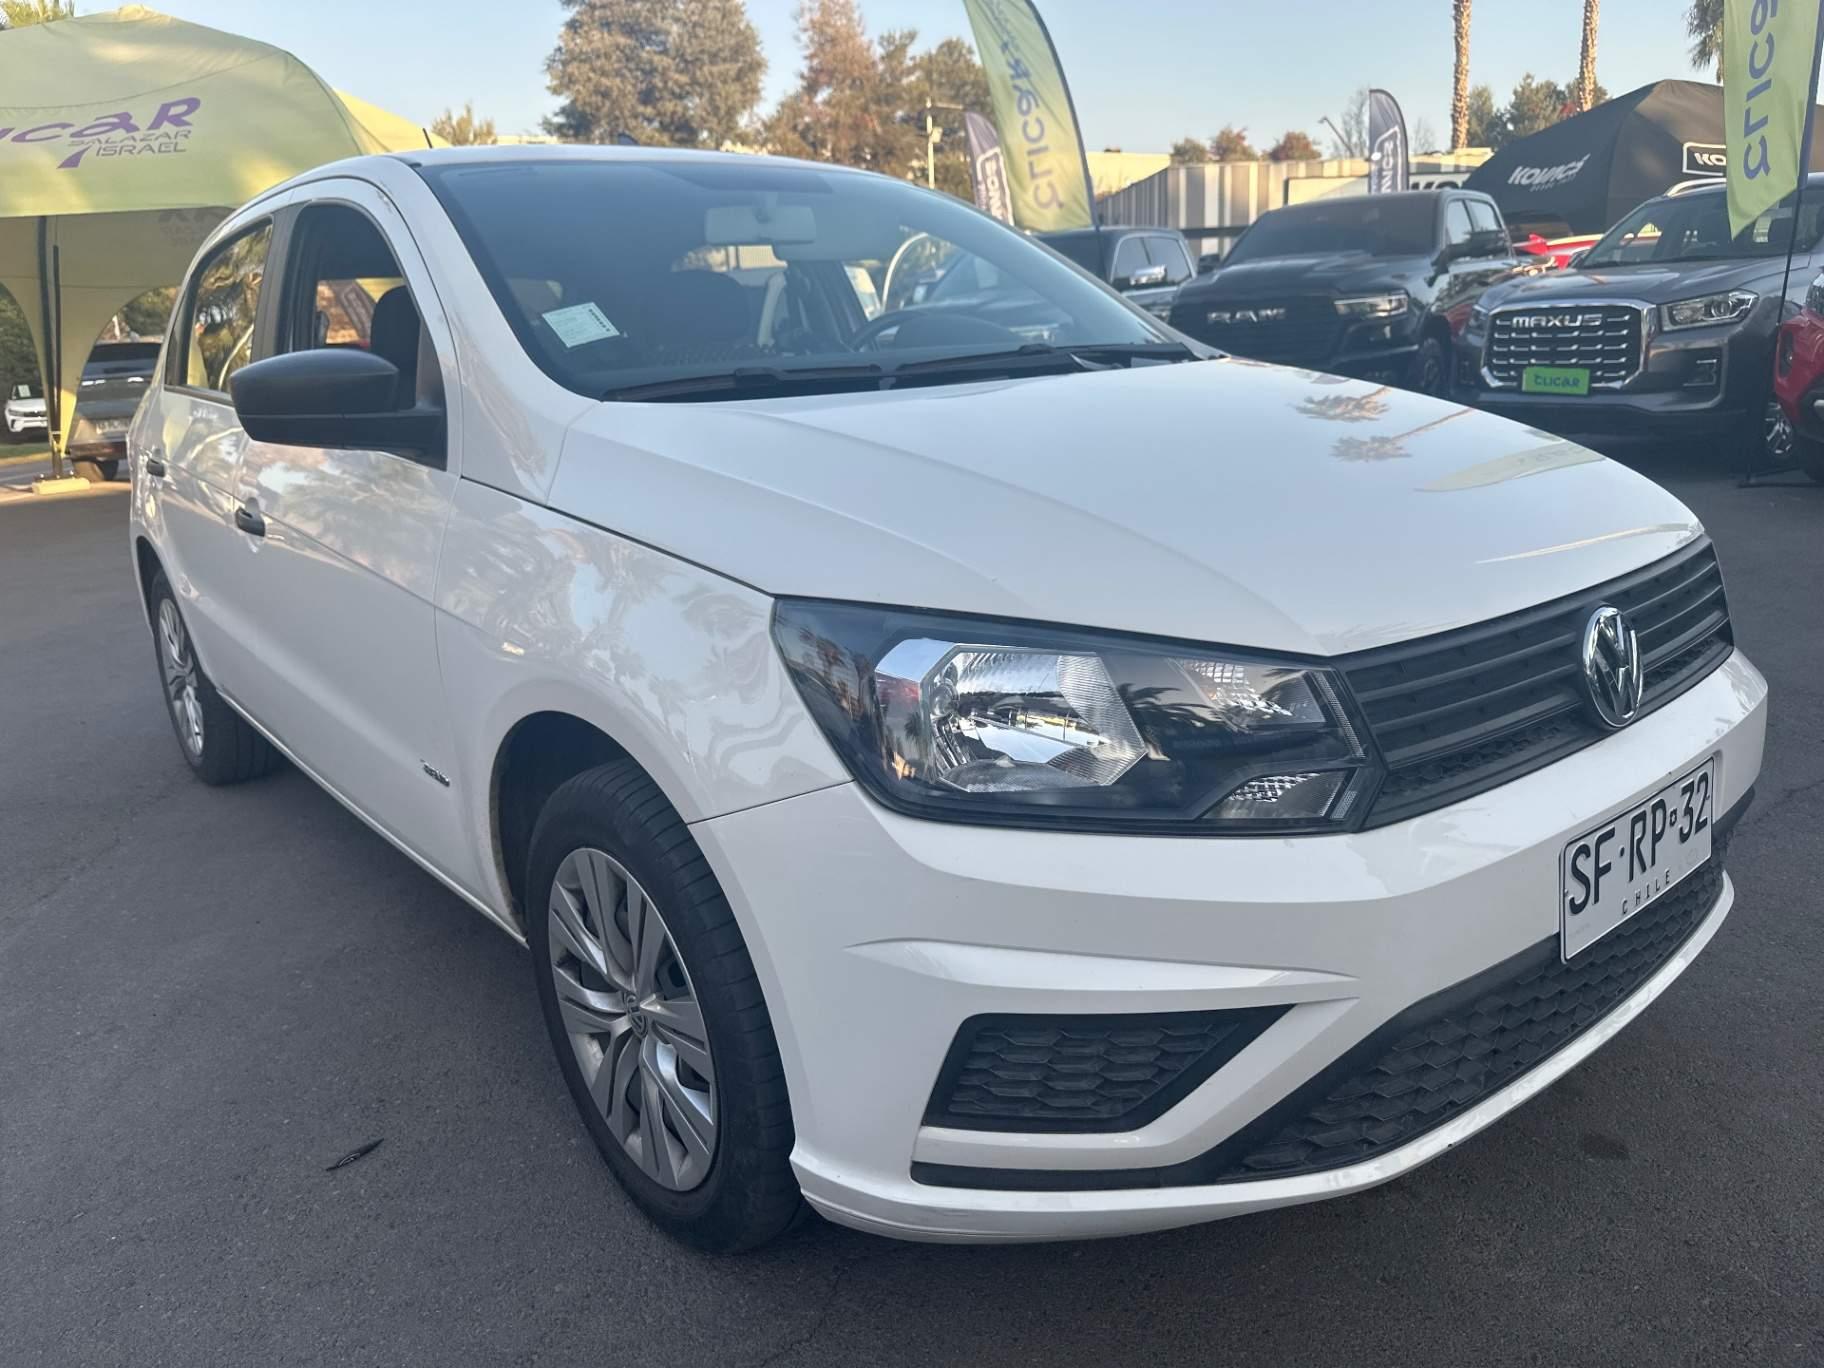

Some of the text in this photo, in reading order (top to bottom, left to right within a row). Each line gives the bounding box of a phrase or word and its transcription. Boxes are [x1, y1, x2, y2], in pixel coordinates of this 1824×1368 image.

[68, 129, 192, 147] SALAZAR
[95, 142, 187, 157] ISRAEL
[1207, 307, 1286, 324] RAM
[1512, 313, 1603, 328] MAXUS
[1621, 868, 1671, 915] CHILE
